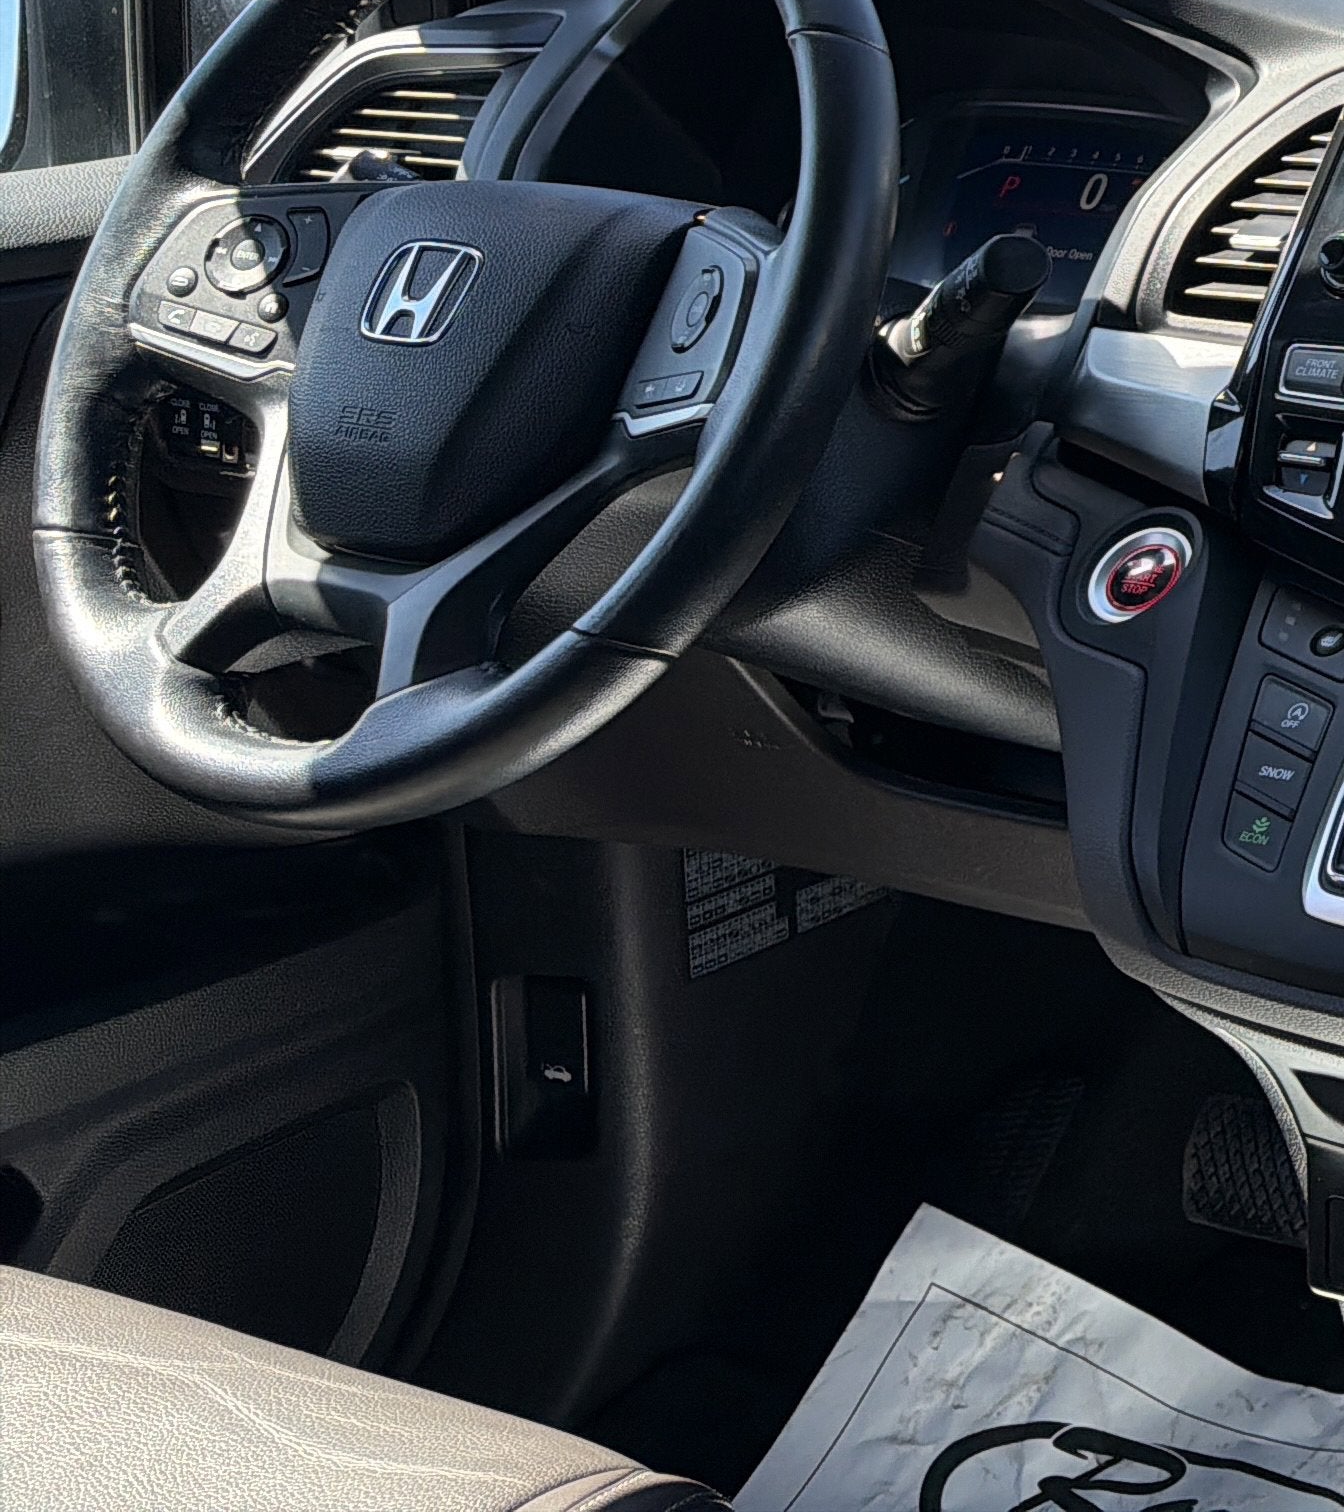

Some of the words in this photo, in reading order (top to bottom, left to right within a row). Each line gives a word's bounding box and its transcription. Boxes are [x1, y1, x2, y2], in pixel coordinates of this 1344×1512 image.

[1000, 175, 1022, 198] P
[1079, 173, 1109, 211] 0
[1047, 245, 1067, 259] Door
[1068, 248, 1094, 262] Open
[1305, 357, 1336, 369] FRONT
[1295, 366, 1339, 379] CLIMATE
[1121, 583, 1148, 595] STOP
[1281, 719, 1300, 729] OFF
[1258, 765, 1296, 781] SNOW
[1238, 830, 1270, 846] ECON
